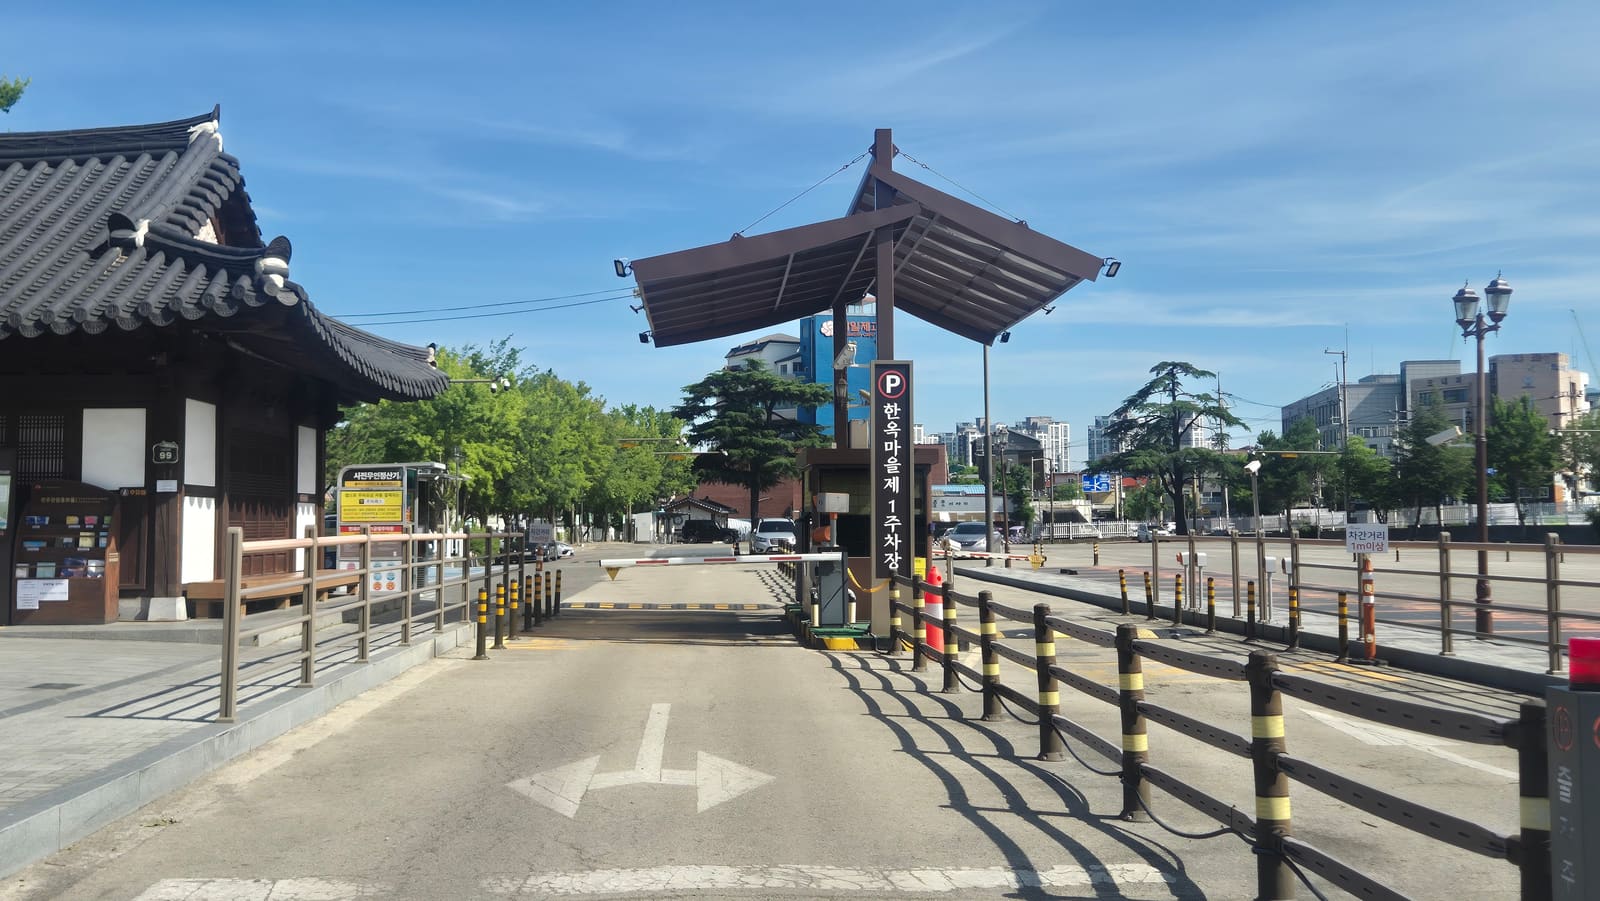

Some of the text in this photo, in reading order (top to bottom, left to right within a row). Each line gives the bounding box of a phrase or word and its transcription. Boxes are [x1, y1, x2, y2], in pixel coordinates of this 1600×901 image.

[886, 375, 900, 393] P
[160, 452, 172, 460] 99
[1349, 531, 1385, 540] 차간거리
[1352, 542, 1384, 551] 1m이상
